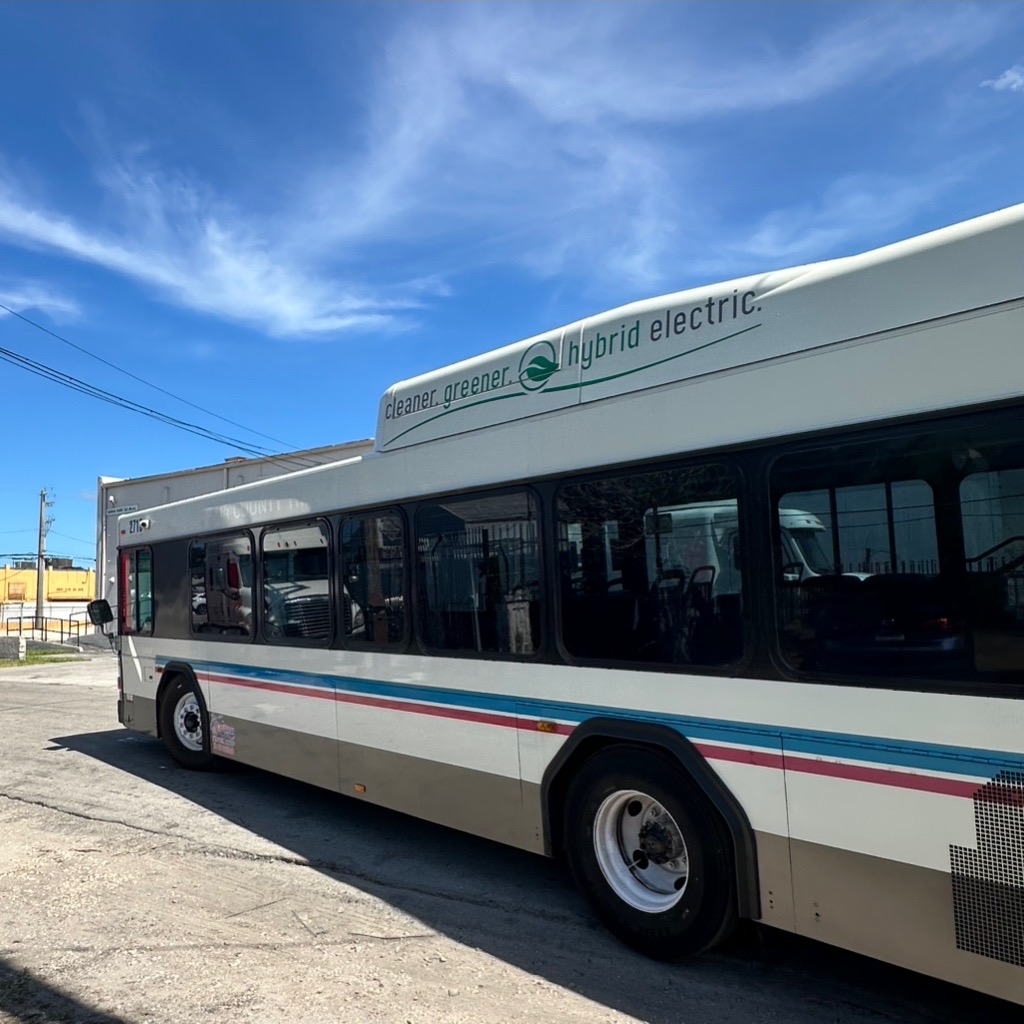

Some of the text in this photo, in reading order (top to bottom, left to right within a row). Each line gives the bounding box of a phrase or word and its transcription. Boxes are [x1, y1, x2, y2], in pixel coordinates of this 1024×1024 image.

[568, 289, 762, 370] hybrid electric.
[385, 364, 513, 420] cleaner. greener.
